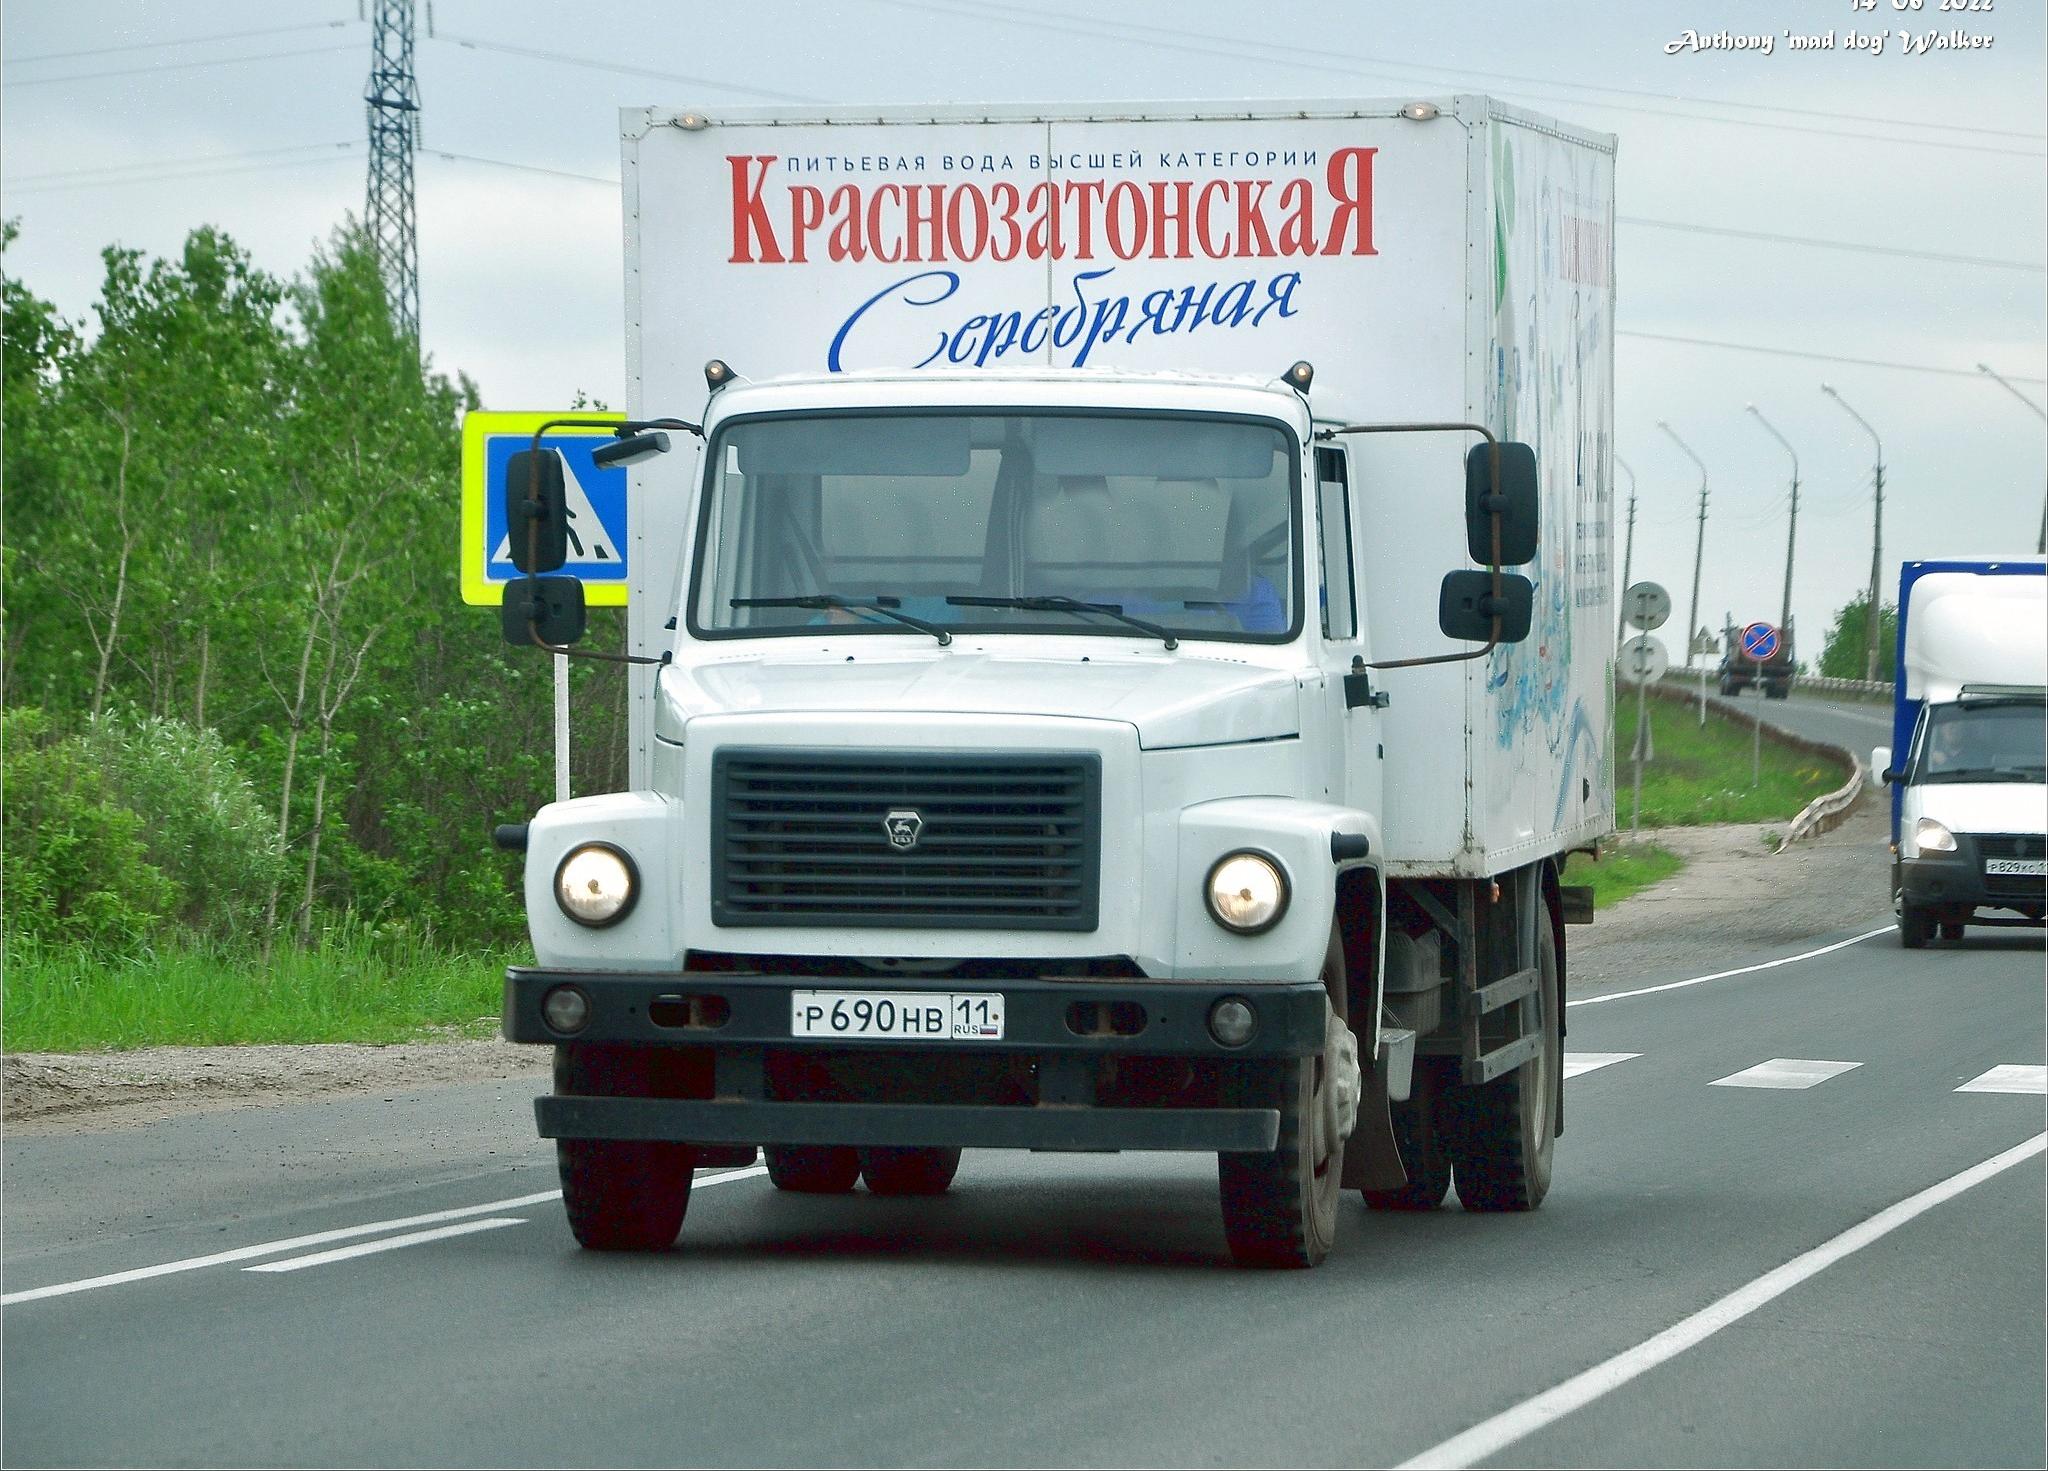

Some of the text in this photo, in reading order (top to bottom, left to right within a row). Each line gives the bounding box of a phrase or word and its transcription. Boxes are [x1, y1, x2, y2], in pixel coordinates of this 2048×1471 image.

[787, 150, 1319, 173] ПИТЬЕВАЯ ВОДА ВЫСШЕЙ КАТЕГОРИИ
[827, 267, 1303, 372] Серебряная
[957, 999, 988, 1025] 11
[954, 1025, 979, 1035] RUS
